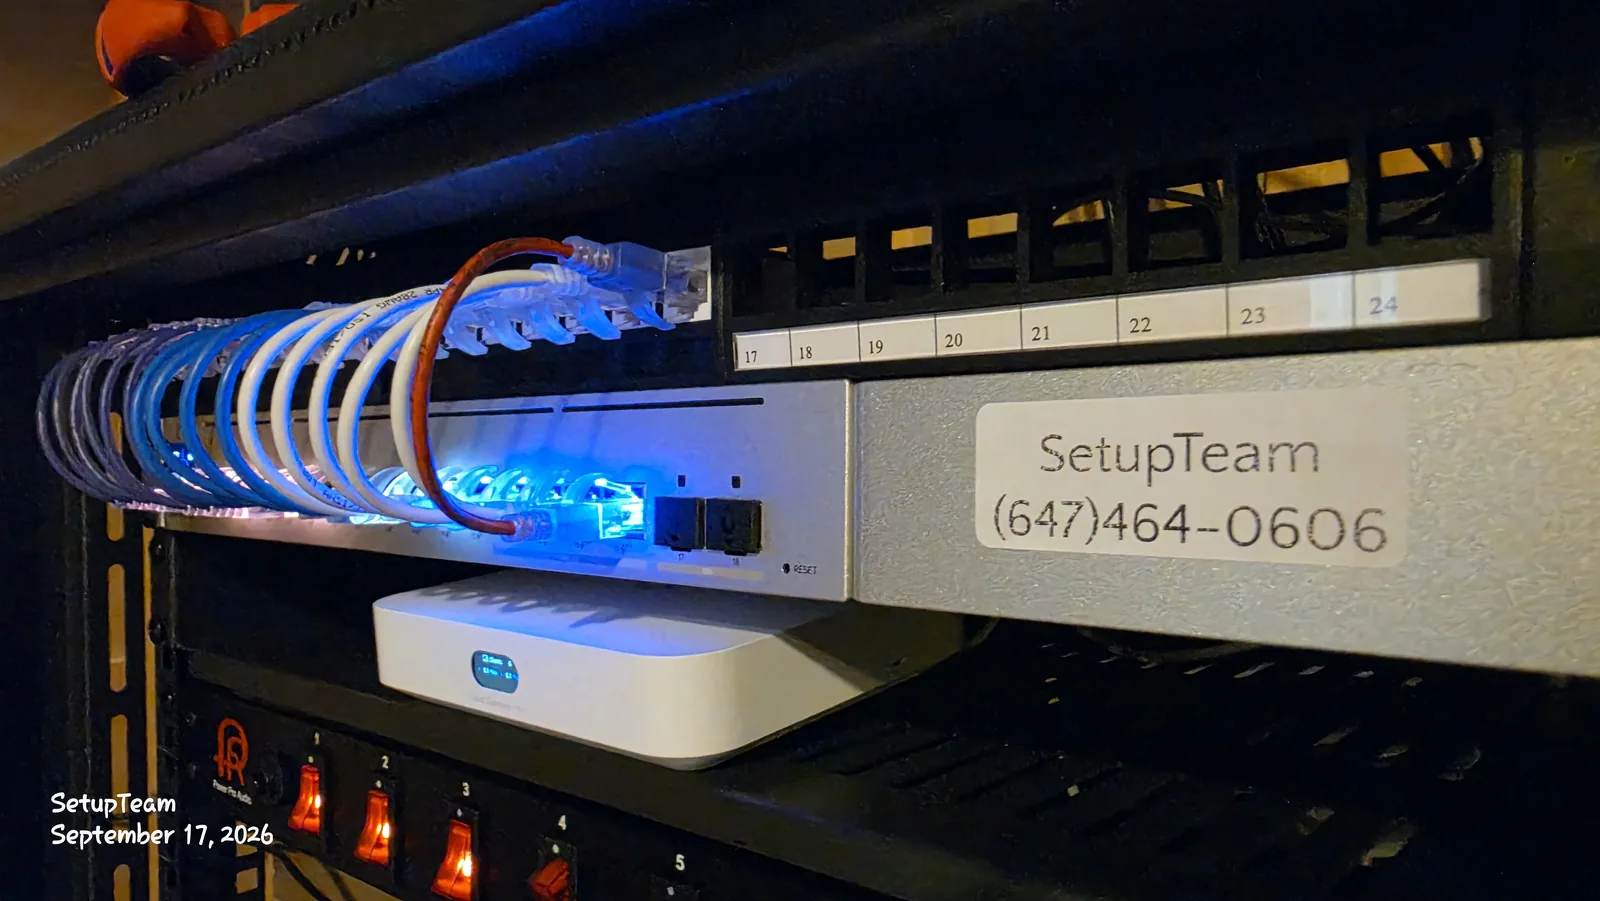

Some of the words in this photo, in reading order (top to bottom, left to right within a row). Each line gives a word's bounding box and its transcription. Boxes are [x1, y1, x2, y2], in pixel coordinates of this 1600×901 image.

[745, 350, 758, 364] 17
[799, 346, 813, 360] 18
[868, 340, 884, 355] 19
[944, 333, 963, 349] 20
[1031, 325, 1050, 342] 21
[1129, 316, 1153, 334] 22
[1240, 306, 1266, 325] 23
[1369, 296, 1398, 315] 24
[1040, 431, 1320, 488] SetupTeam
[993, 493, 1388, 554] (647)464-0606
[793, 564, 818, 575] RESET
[313, 732, 320, 745] 1
[381, 755, 389, 769] 2
[461, 782, 470, 797] 3
[557, 814, 567, 831] 4
[675, 853, 685, 871] 5
